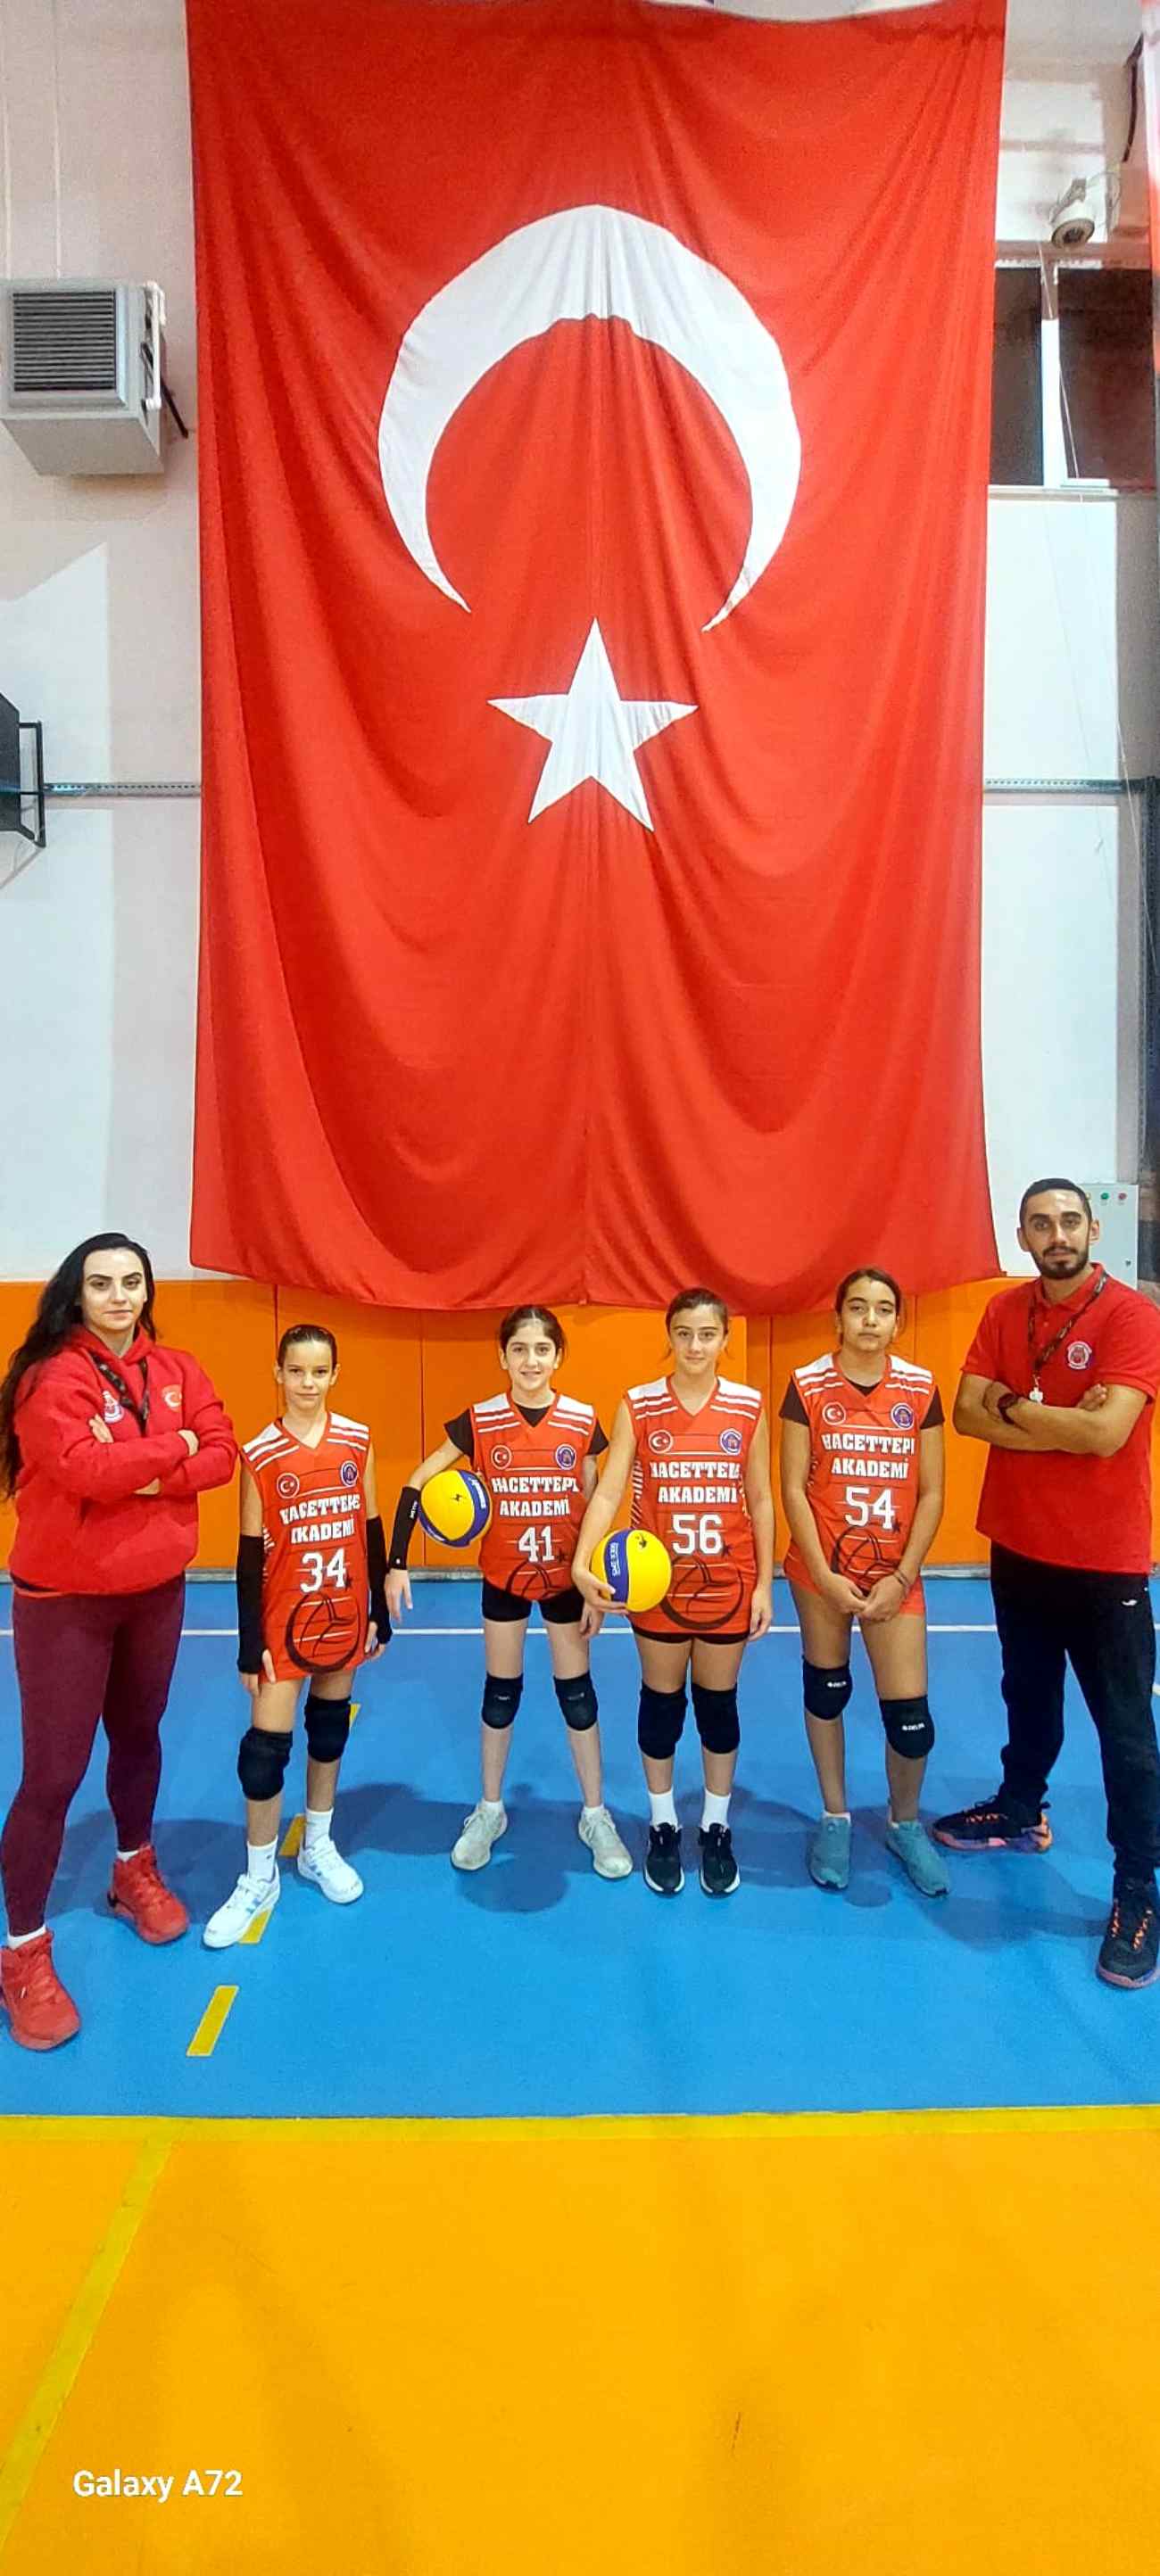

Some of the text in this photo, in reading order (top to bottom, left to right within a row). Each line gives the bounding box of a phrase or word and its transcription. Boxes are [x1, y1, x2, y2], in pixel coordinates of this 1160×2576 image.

[831, 1456, 909, 1479] AKADEMİ
[500, 1494, 571, 1516] AKADEMİ
[659, 1482, 738, 1503] AKADEMİ
[844, 1485, 896, 1531] 54
[518, 1526, 556, 1563] 41
[672, 1513, 724, 1556] 56
[300, 1548, 347, 1594] 34
